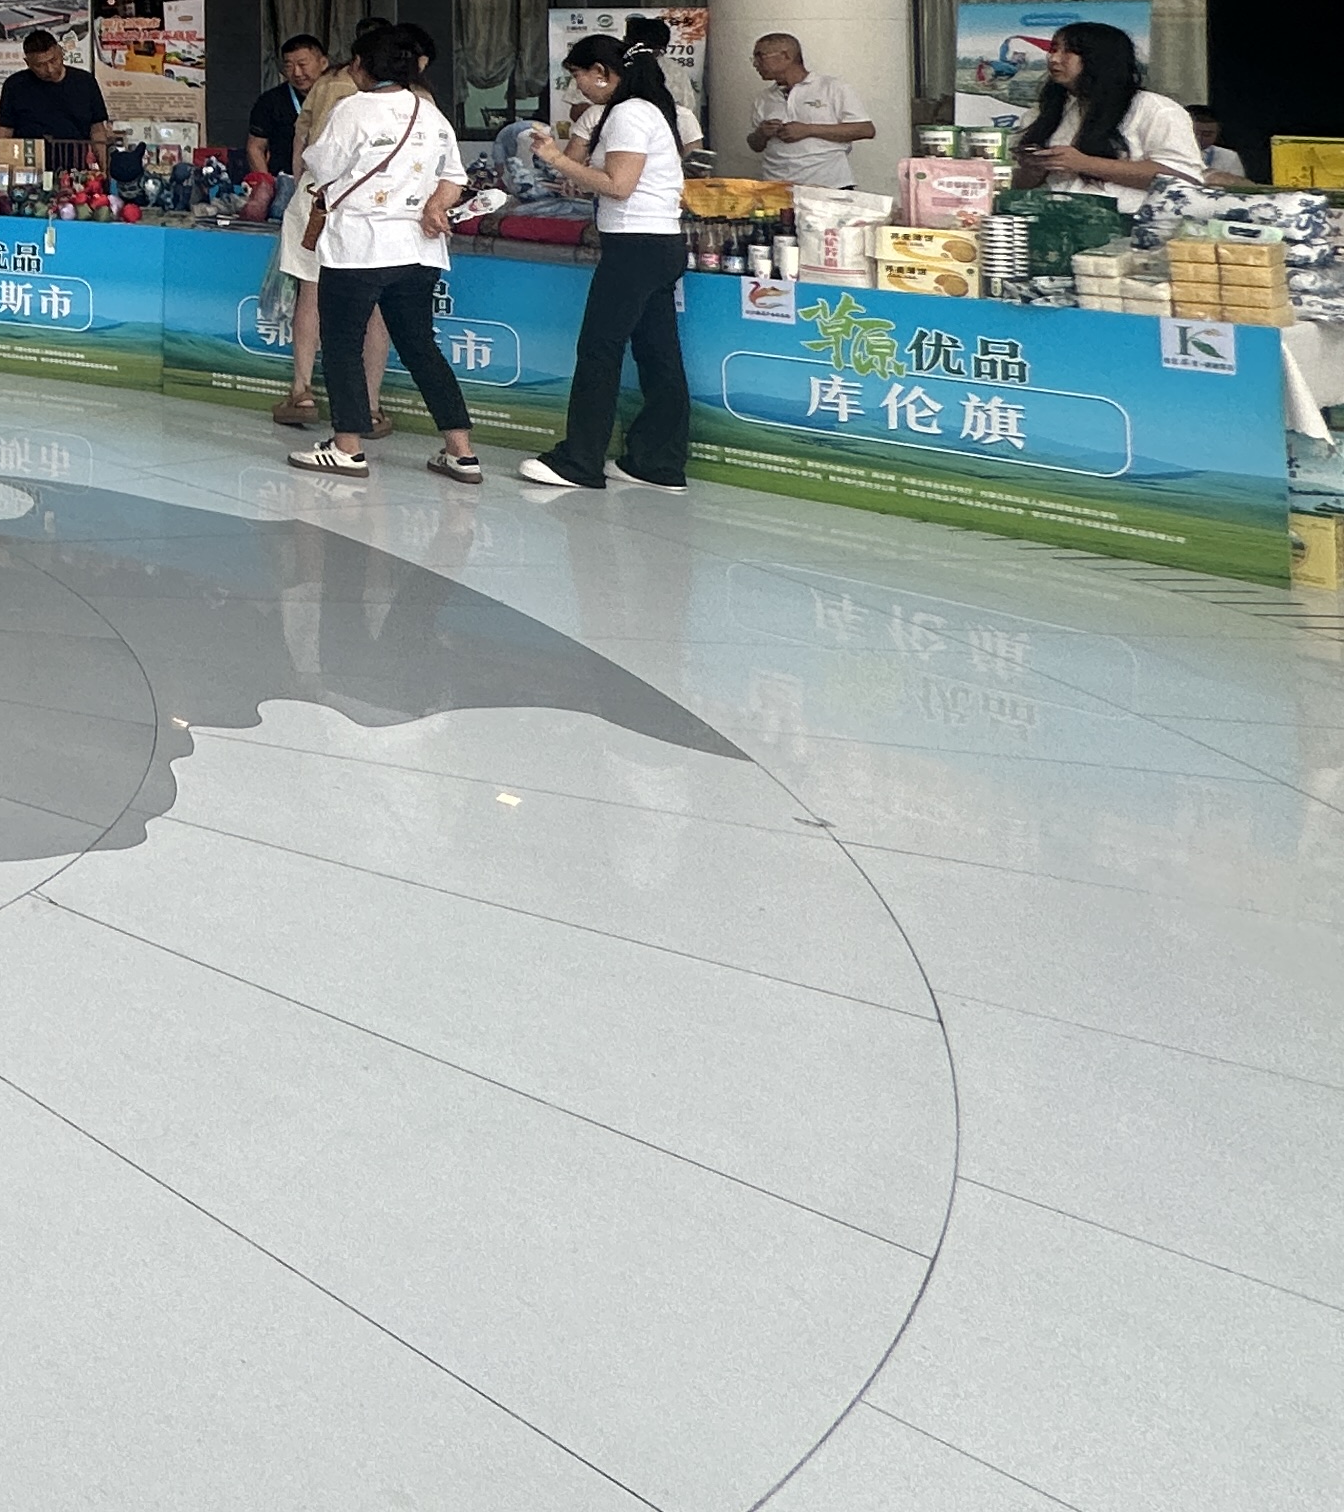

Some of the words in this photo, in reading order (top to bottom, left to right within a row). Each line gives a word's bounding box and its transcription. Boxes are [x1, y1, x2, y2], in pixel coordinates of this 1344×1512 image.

[797, 292, 1030, 385] 草原优品
[806, 373, 1028, 451] 库伦旗
